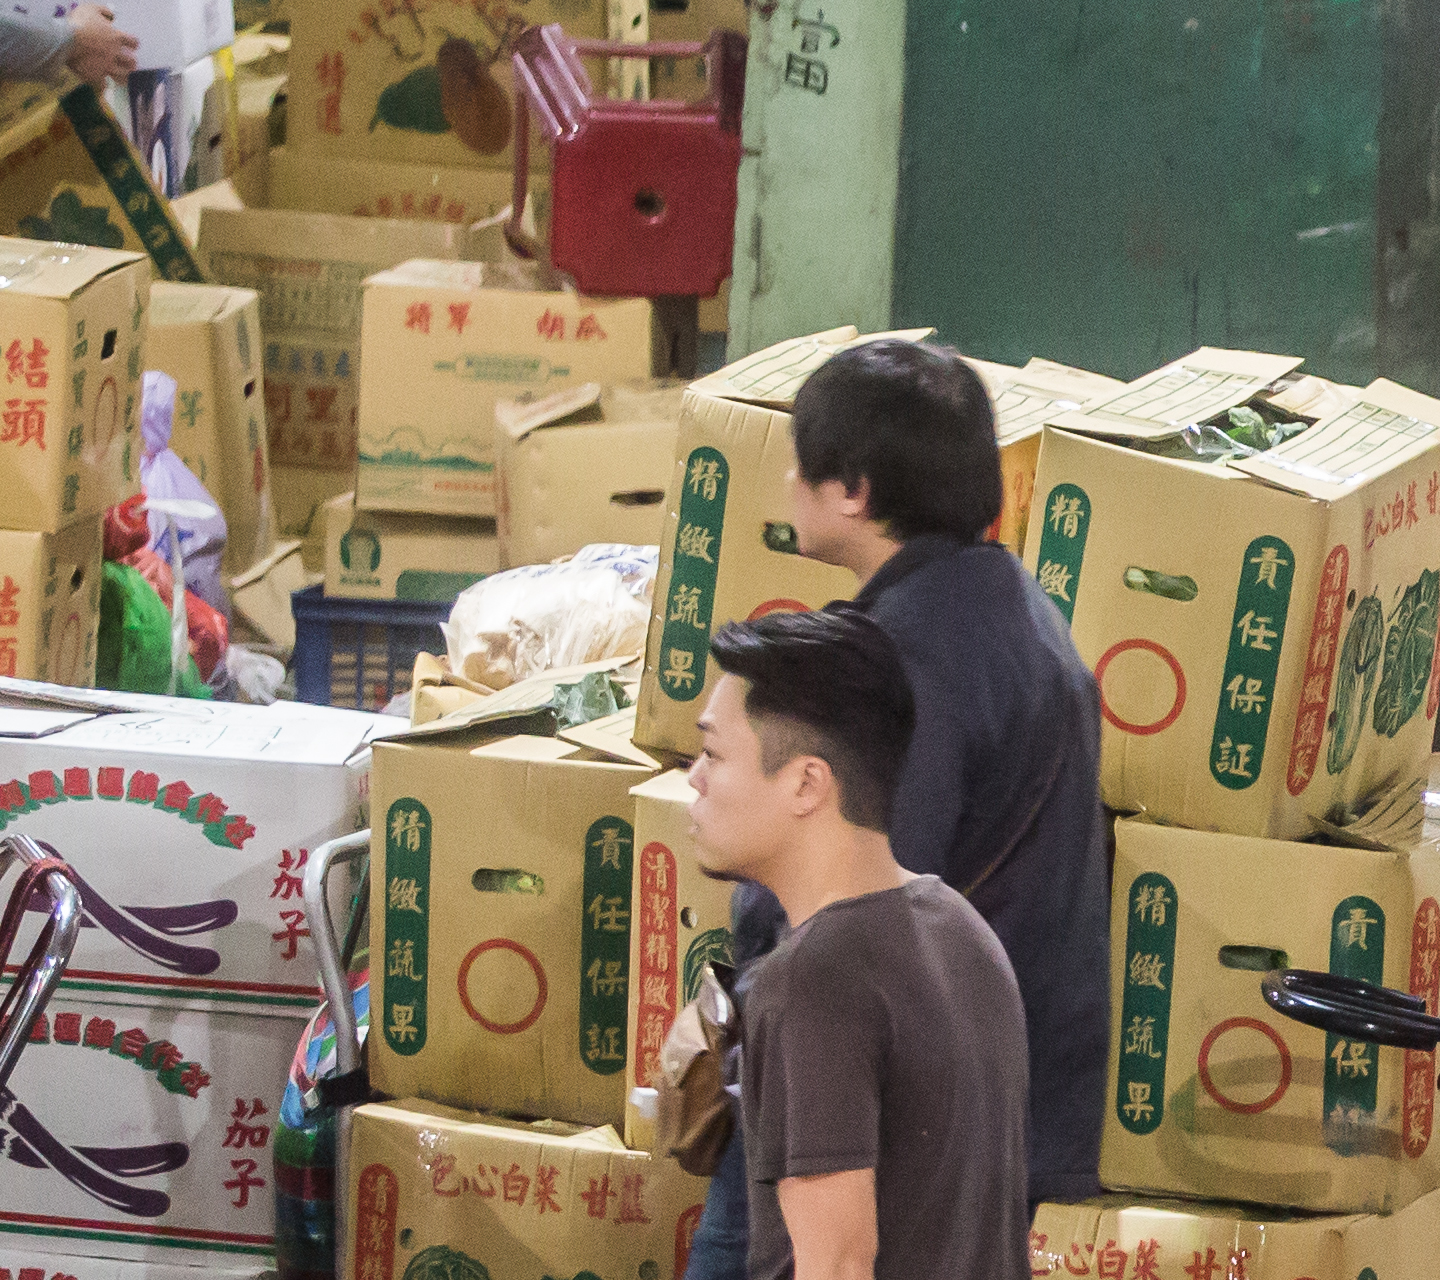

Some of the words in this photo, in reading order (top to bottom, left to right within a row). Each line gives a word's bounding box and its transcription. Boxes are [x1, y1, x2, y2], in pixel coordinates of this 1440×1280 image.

[661, 456, 724, 693] 精緻蔬果
[270, 847, 310, 961] 茄子
[386, 807, 426, 1045] 精緻蔬果
[1120, 883, 1168, 1123] 精緻蔬果
[221, 1097, 271, 1210] 茄子
